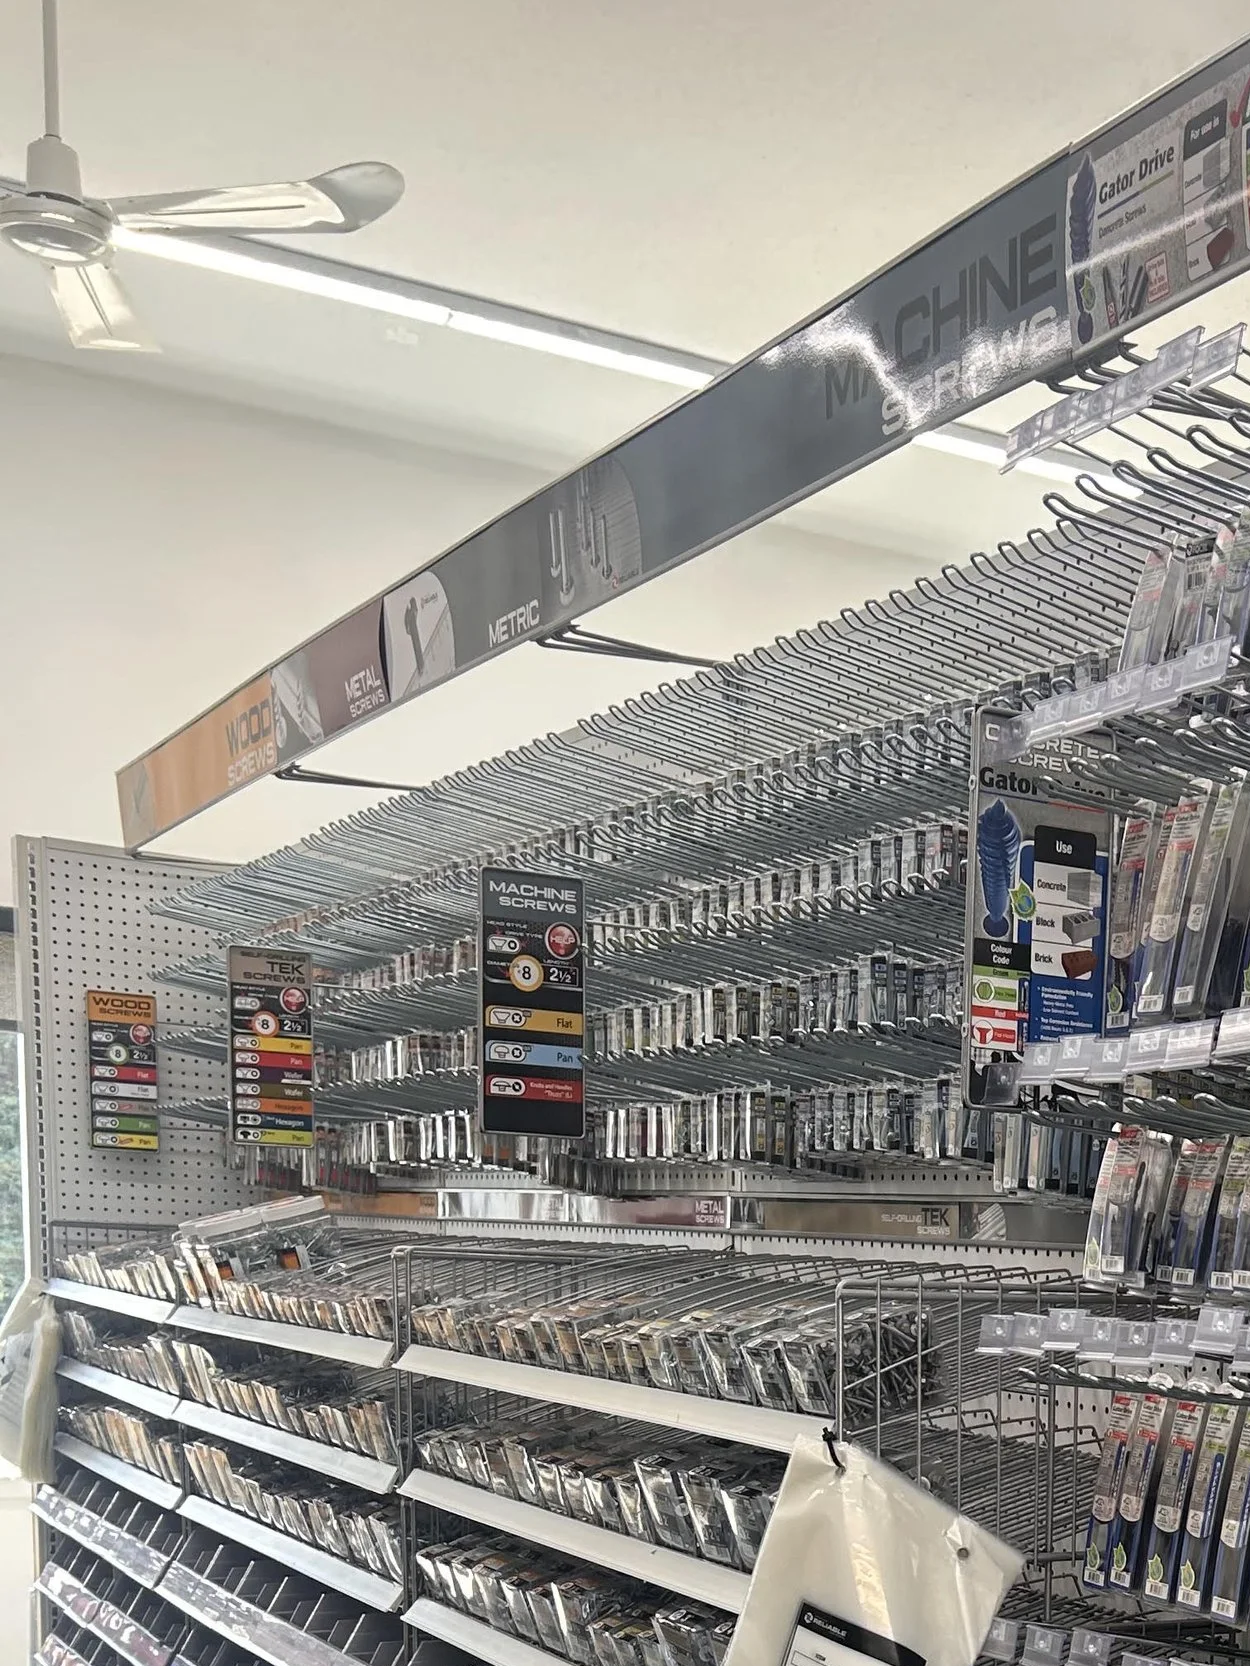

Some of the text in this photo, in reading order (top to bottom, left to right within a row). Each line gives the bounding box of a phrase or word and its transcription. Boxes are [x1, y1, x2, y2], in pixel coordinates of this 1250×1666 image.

[1099, 145, 1175, 204] Gator Drive
[489, 599, 540, 648] METRIC
[345, 665, 381, 701] METAL
[350, 688, 386, 718] SCREWS
[226, 698, 272, 757] WOOD
[228, 742, 276, 786] SCREWS
[1056, 840, 1073, 854] Use
[489, 880, 578, 902] MACHINE
[1037, 879, 1067, 893] Concrete
[499, 896, 578, 915] SCREWS
[1035, 916, 1056, 929] Block
[550, 935, 576, 945] HELP
[990, 944, 1013, 954] Colour
[992, 954, 1010, 965] Code
[1034, 952, 1053, 964] Brick
[266, 960, 304, 976] TEK
[522, 965, 532, 980] 8
[243, 971, 306, 984] SCREWS
[92, 996, 151, 1010] WOOD
[99, 1007, 152, 1018] SCREWS
[261, 1018, 269, 1030] 8
[556, 1018, 573, 1029] Flat
[290, 1042, 303, 1050] Pan
[115, 1049, 122, 1059] 8
[557, 1052, 573, 1063] Pan
[290, 1057, 303, 1065] Pan
[137, 1071, 149, 1079] Flat
[284, 1088, 303, 1096] Wafer
[275, 1118, 304, 1127] Hexagon
[292, 1134, 304, 1142] Pan
[696, 1200, 724, 1214] METAL
[695, 1214, 725, 1224] SCREWS
[921, 1207, 951, 1226] TEK
[916, 1225, 951, 1236] SCREWS
[813, 1617, 847, 1637] RELIABLE
